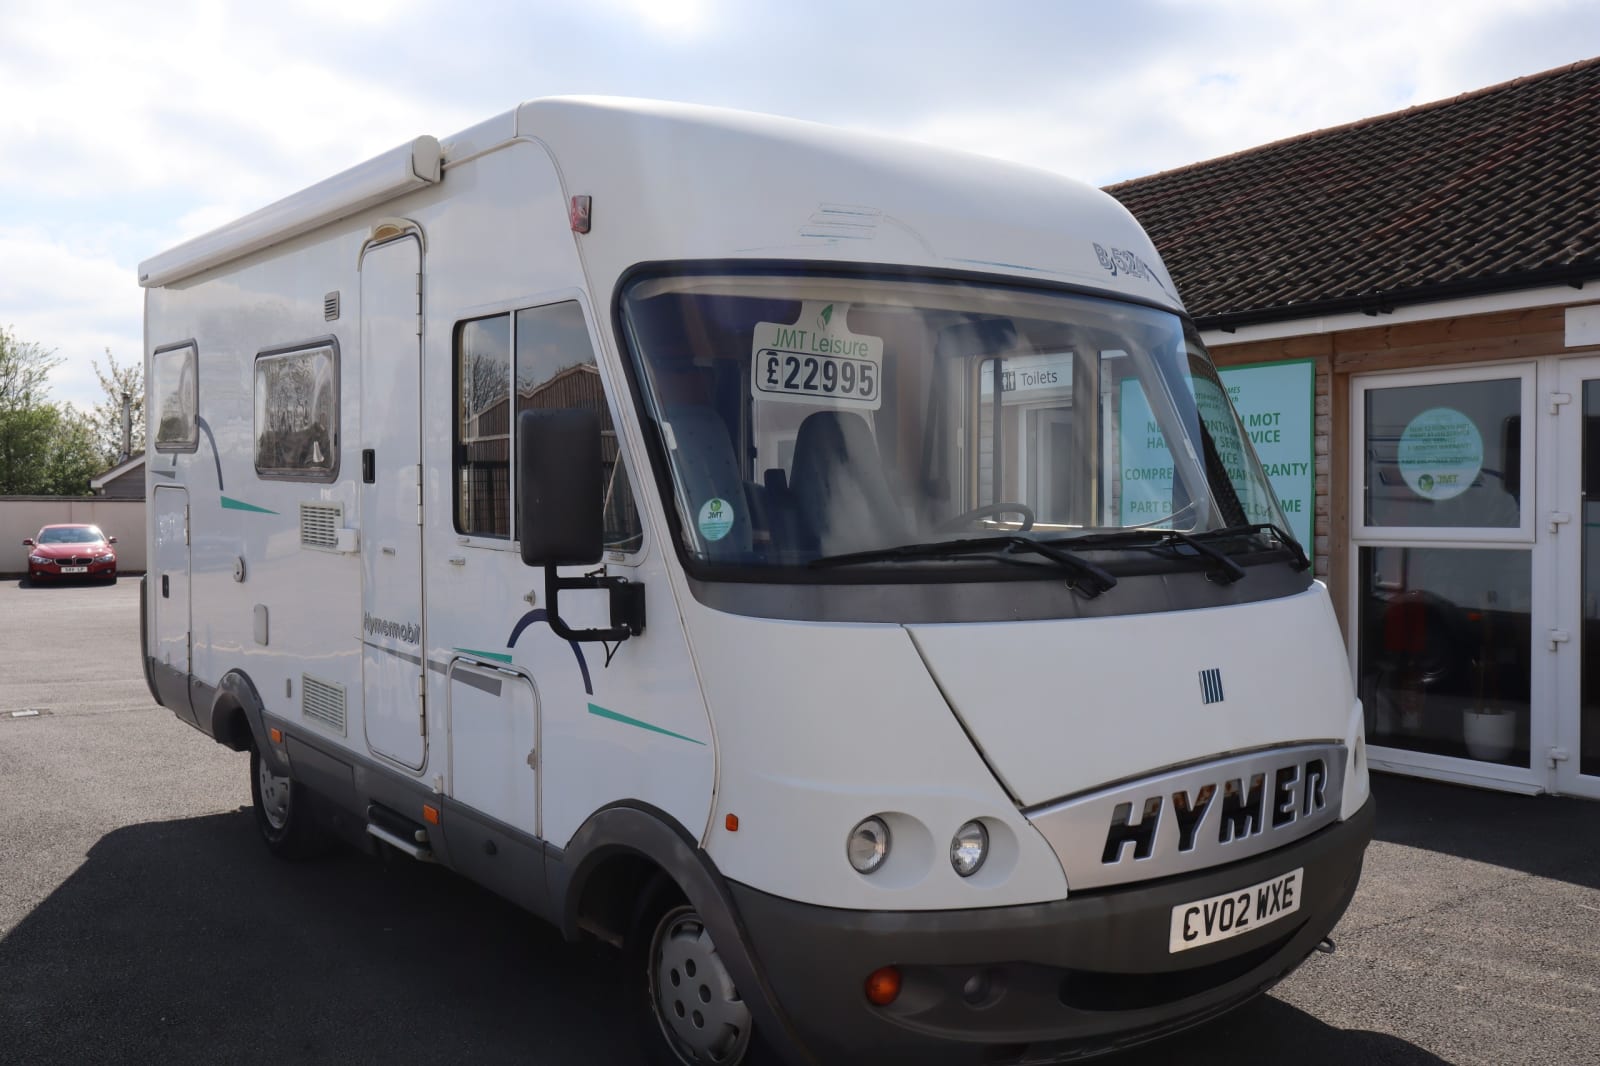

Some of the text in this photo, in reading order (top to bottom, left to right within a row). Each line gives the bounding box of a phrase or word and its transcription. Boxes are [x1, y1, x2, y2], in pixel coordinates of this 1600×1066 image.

[772, 327, 868, 357] JMT Leisure
[766, 351, 874, 397] £22995
[1020, 371, 1058, 387] Toilets
[1249, 412, 1281, 427] MOT
[1125, 467, 1173, 481] COMPRE
[1130, 501, 1158, 513] PART
[363, 610, 420, 646] Hymermobil
[1101, 758, 1328, 865] HYMER
[1182, 875, 1296, 942] CV02 WXE
